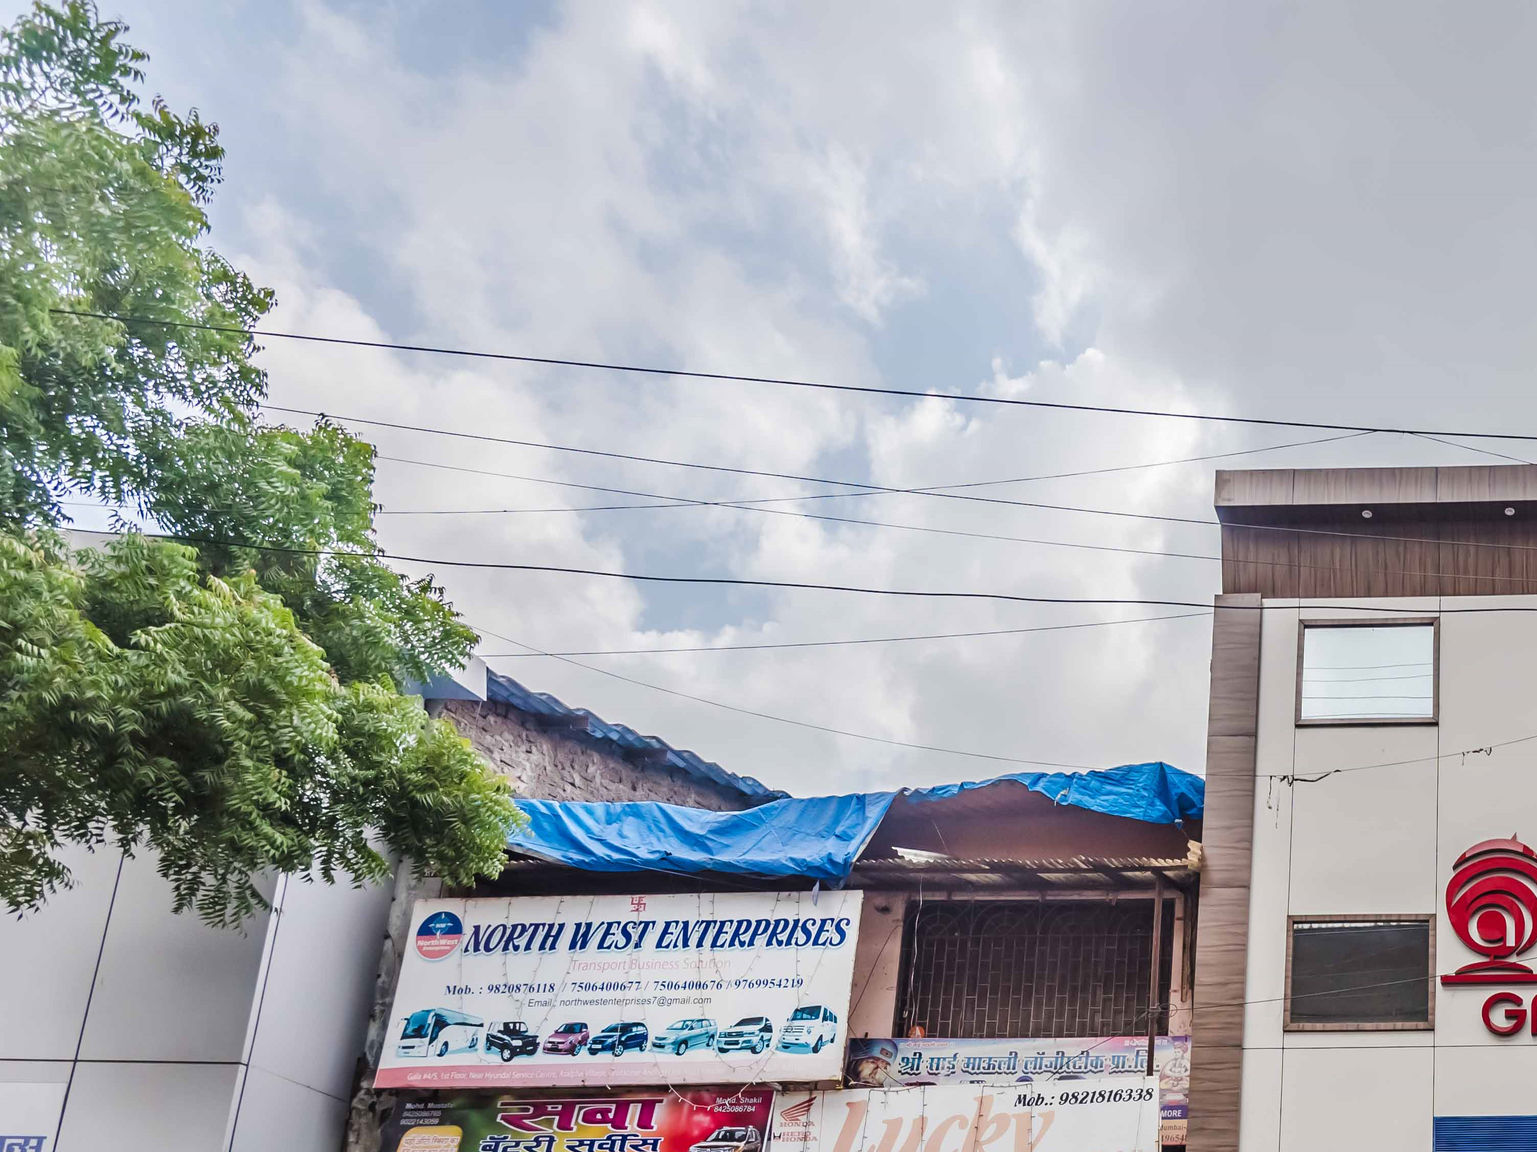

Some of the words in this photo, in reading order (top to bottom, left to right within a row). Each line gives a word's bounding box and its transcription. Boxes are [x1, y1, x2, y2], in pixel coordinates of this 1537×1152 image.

[464, 922, 566, 954] NORTH
[568, 919, 656, 952] WEST
[655, 917, 851, 950] ENTERPRISES
[571, 959, 627, 974] Transport
[631, 958, 680, 971] Business
[682, 957, 731, 970] Solution
[444, 985, 475, 995] Mob.
[487, 982, 556, 994] 9820876118
[571, 980, 641, 993] 7506400677
[653, 979, 723, 991] 7506400676
[734, 977, 804, 990] 9769954219
[559, 996, 712, 1009] northwestenterprises7@gmail.com
[899, 1051, 922, 1076] श्री
[740, 1096, 763, 1104] Shakil
[1058, 1087, 1154, 1106] 9821816338
[497, 1098, 665, 1133] सबा
